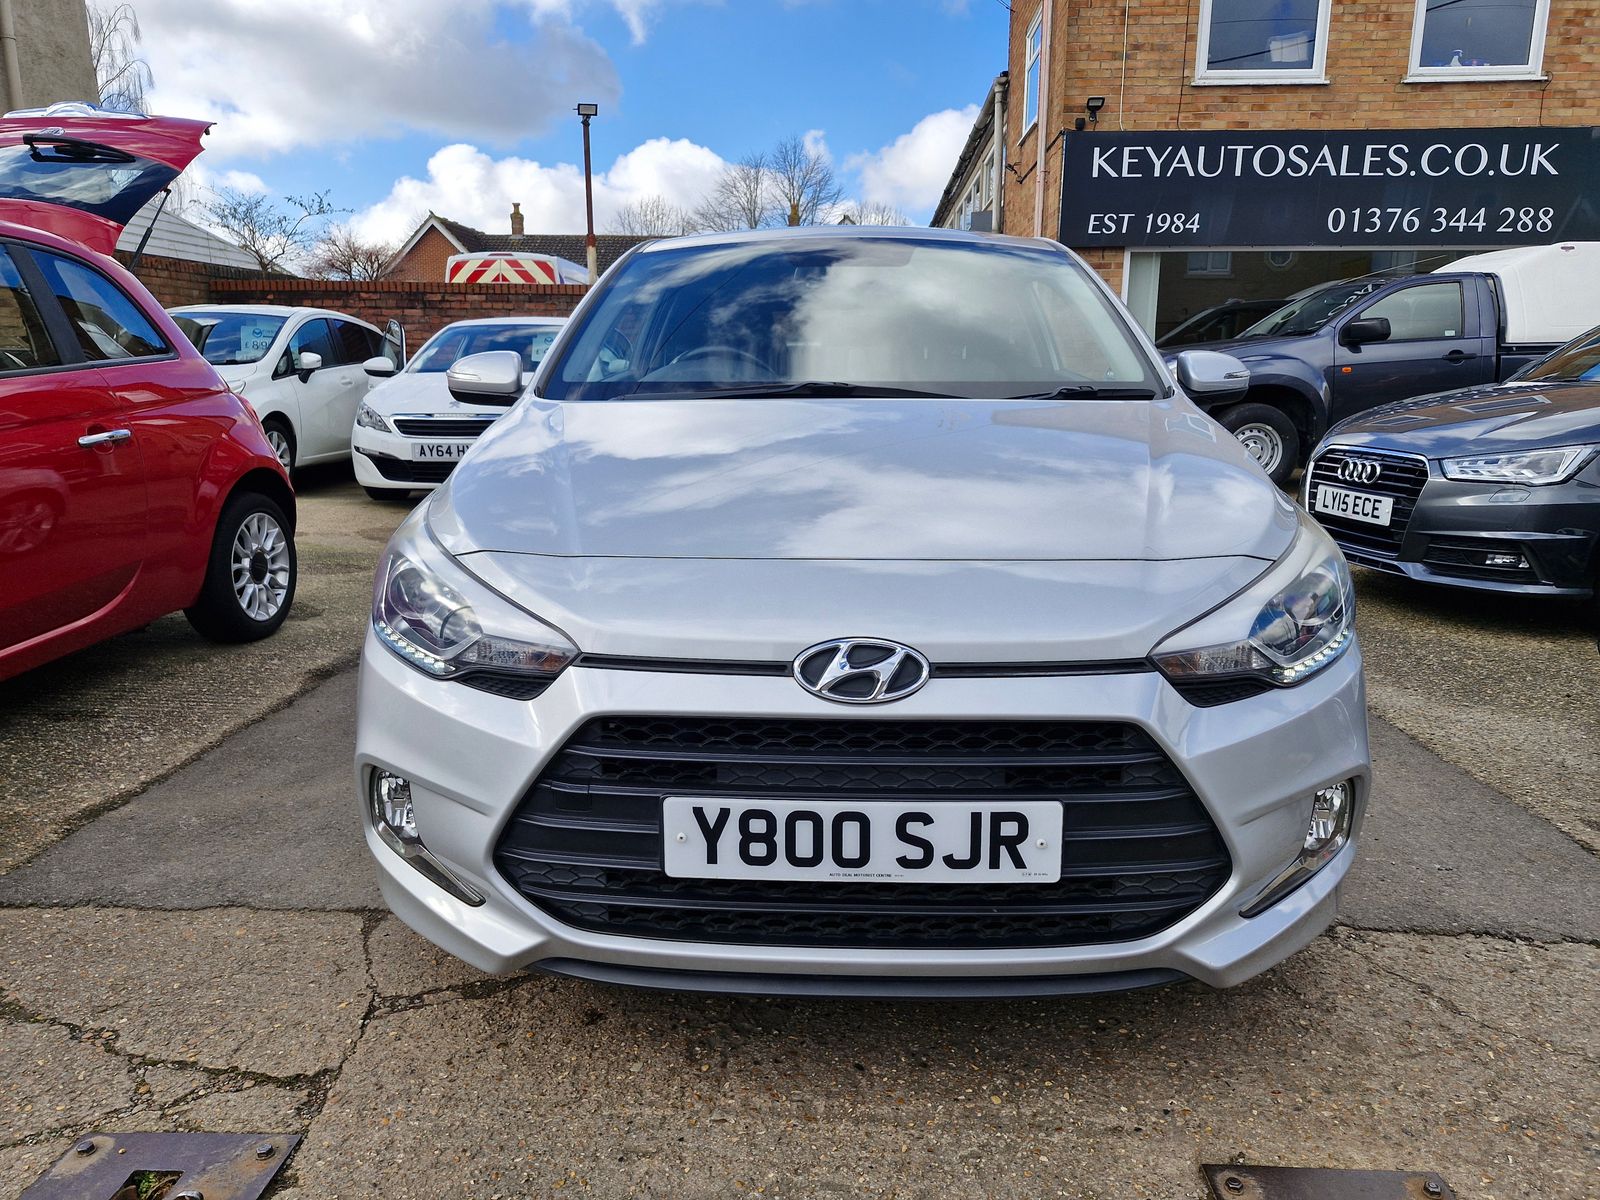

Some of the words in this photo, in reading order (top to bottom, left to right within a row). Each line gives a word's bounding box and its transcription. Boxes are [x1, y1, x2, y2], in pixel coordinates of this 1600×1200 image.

[1091, 143, 1560, 178] KEYAUTOSALES.CO.UK
[1087, 212, 1135, 234] EST
[1146, 212, 1200, 234] 1984
[1327, 207, 1421, 233] 01376
[1430, 207, 1486, 233] 344
[1496, 207, 1554, 233] 288
[419, 445, 453, 457] AY64
[1322, 489, 1350, 513] LY15
[1352, 495, 1383, 520] ECE
[692, 806, 871, 869] Y800
[895, 811, 1029, 870] SJR
